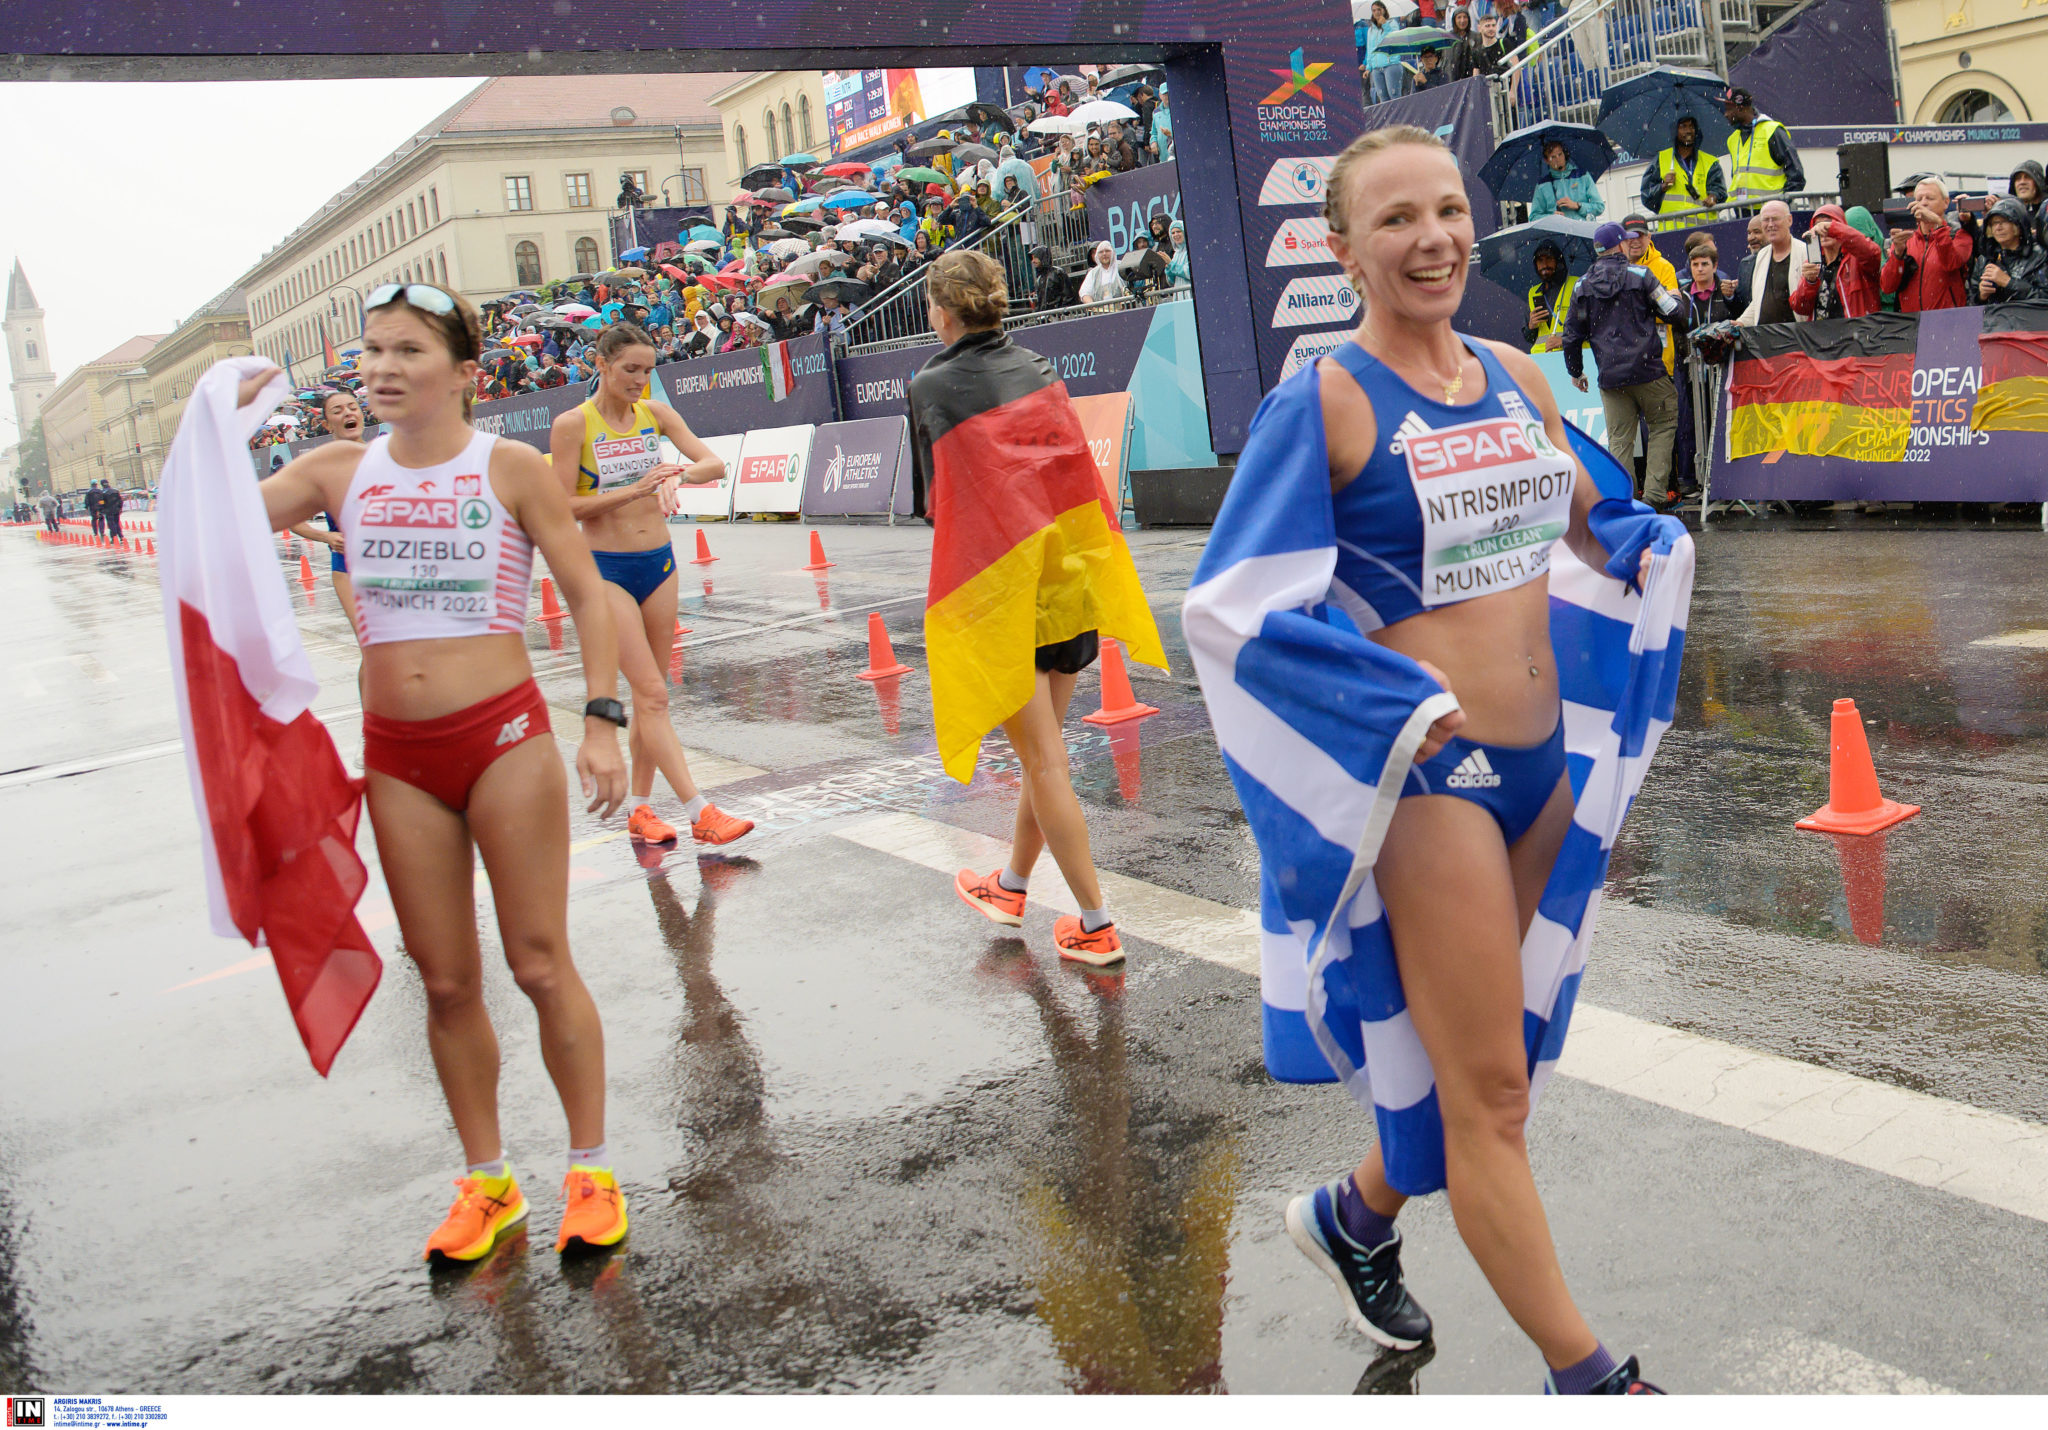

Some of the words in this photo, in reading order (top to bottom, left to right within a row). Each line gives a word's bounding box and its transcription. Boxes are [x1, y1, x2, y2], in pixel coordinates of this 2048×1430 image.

[1257, 106, 1326, 120] EUROPEAN
[1259, 120, 1327, 131] CHAMPIONSHIPS
[1260, 131, 1300, 142] MUNICH
[1304, 130, 1328, 141] 2022
[1844, 132, 1890, 144] EUROPEAN
[1904, 129, 1966, 143] CHAMPIONSHIPS
[1967, 129, 1999, 141] MUNICH
[2001, 128, 2021, 140] 2022
[1287, 293, 1335, 309] Allianz
[675, 374, 709, 395] EUROPEAN
[804, 352, 827, 375] 2022
[1062, 352, 1097, 378] 2022
[856, 378, 905, 404] EUROPEAN
[505, 408, 533, 433] MUNICH
[532, 405, 551, 431] 2022
[1859, 398, 1968, 425] ATHLETICS
[596, 440, 644, 458] SPAR
[1413, 425, 1533, 475] SPAR
[1903, 449, 1931, 462] 2022
[600, 457, 663, 475] OLYANOVSKA
[750, 459, 786, 478] SPAR
[846, 452, 882, 467] EUROPEAN
[843, 466, 879, 480] ATHLETICS
[1426, 470, 1572, 524] NTRISMPIOTI
[363, 501, 456, 525] SPAR
[1490, 513, 1520, 534] 120
[362, 539, 486, 560] ZDZIEBLO
[1470, 537, 1499, 557] RUN
[410, 564, 439, 578] 130
[1434, 555, 1525, 595] MUNICH
[366, 590, 435, 610] MUNICH
[443, 596, 488, 612] 2022
[1446, 772, 1501, 789] adidas
